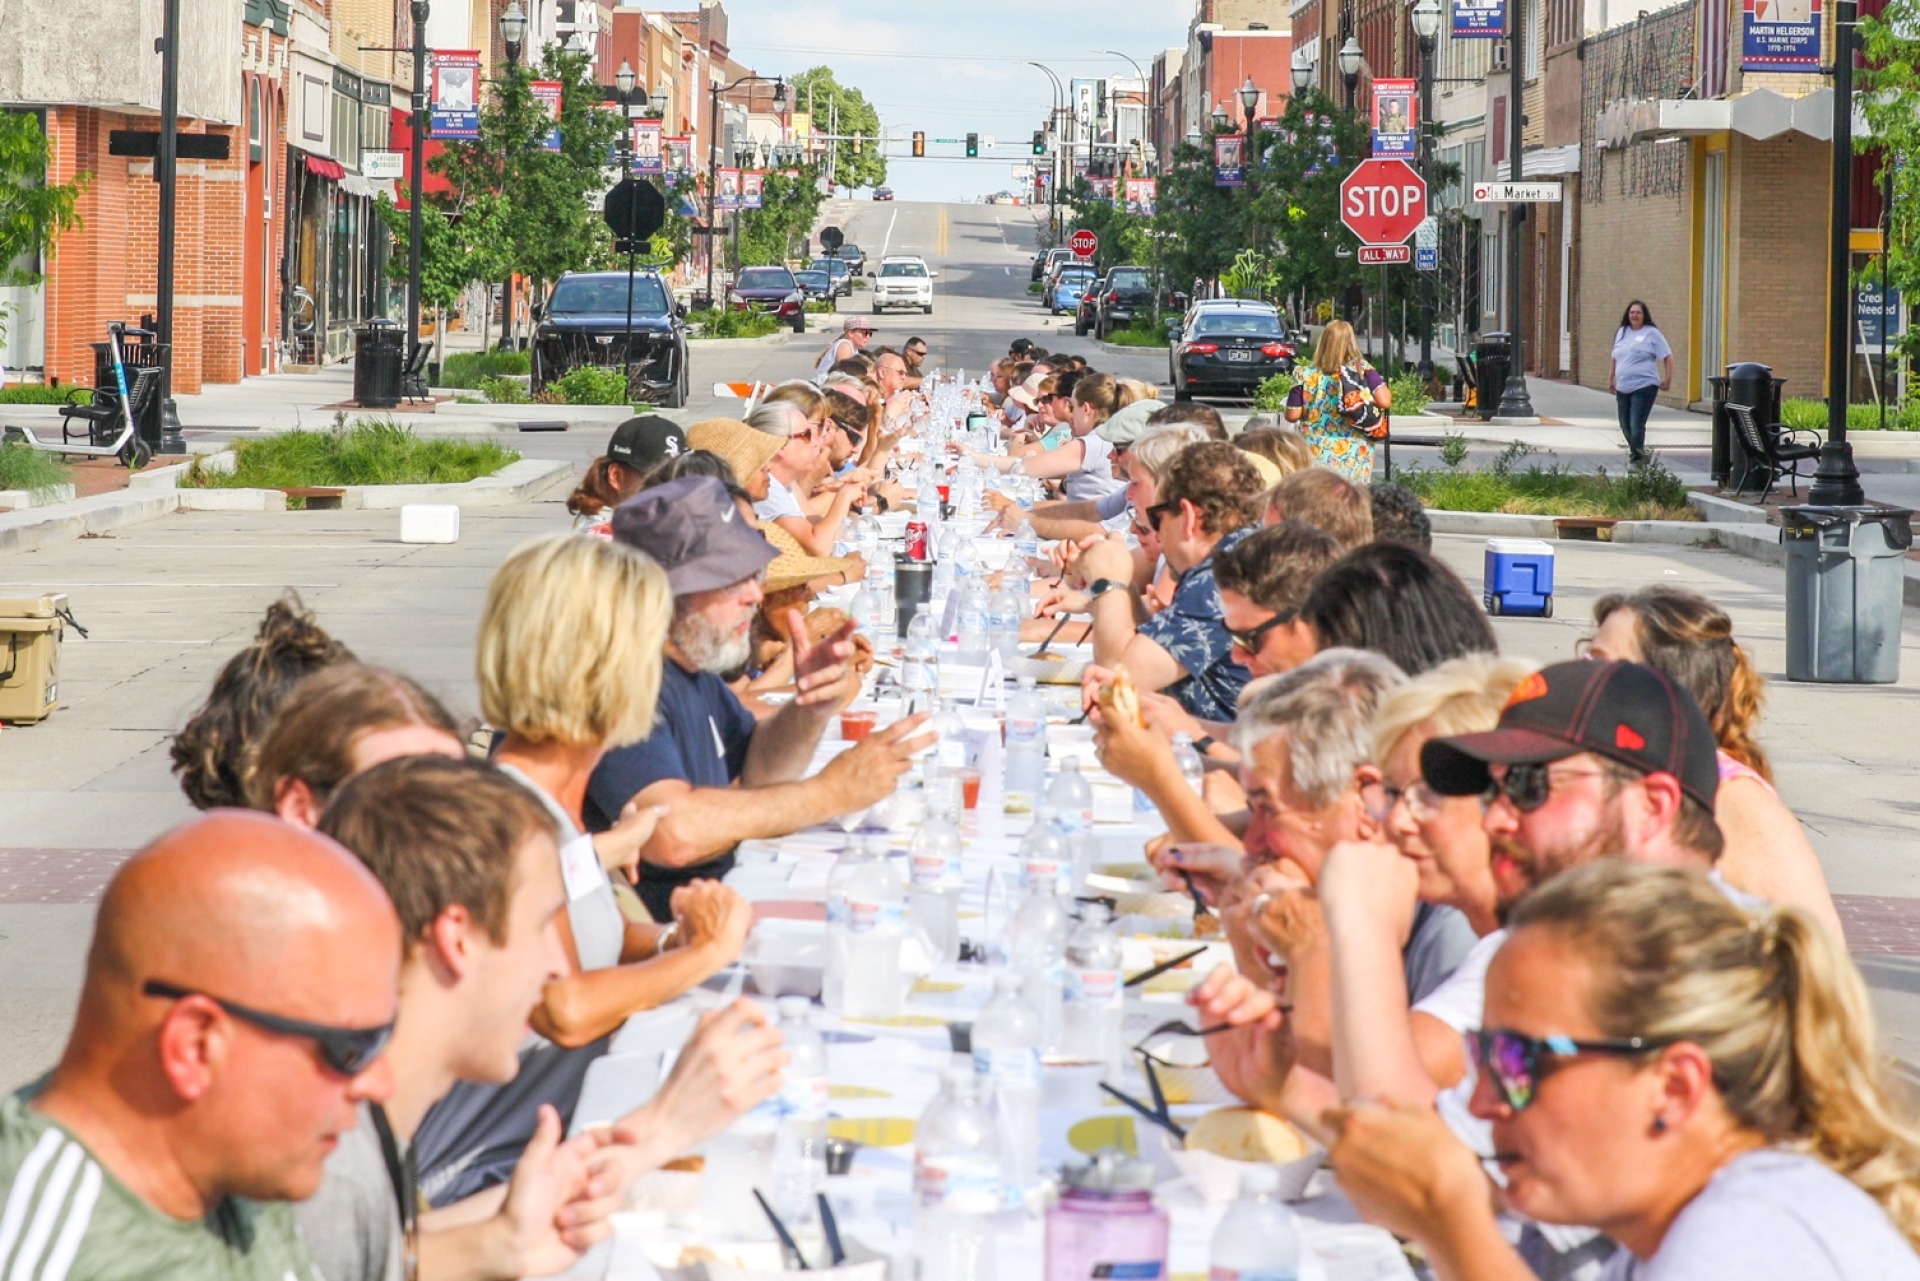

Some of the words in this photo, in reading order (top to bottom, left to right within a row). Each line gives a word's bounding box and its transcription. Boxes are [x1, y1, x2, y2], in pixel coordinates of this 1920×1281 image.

[1749, 26, 1775, 35] MARTIN
[1776, 26, 1815, 36] HELGERSON
[1080, 88, 1090, 140] PAWN
[1504, 185, 1541, 199] Market
[1346, 185, 1421, 217] STOP
[1072, 238, 1096, 249] STOP
[1363, 250, 1381, 260] ALL
[1385, 249, 1405, 259] WAY
